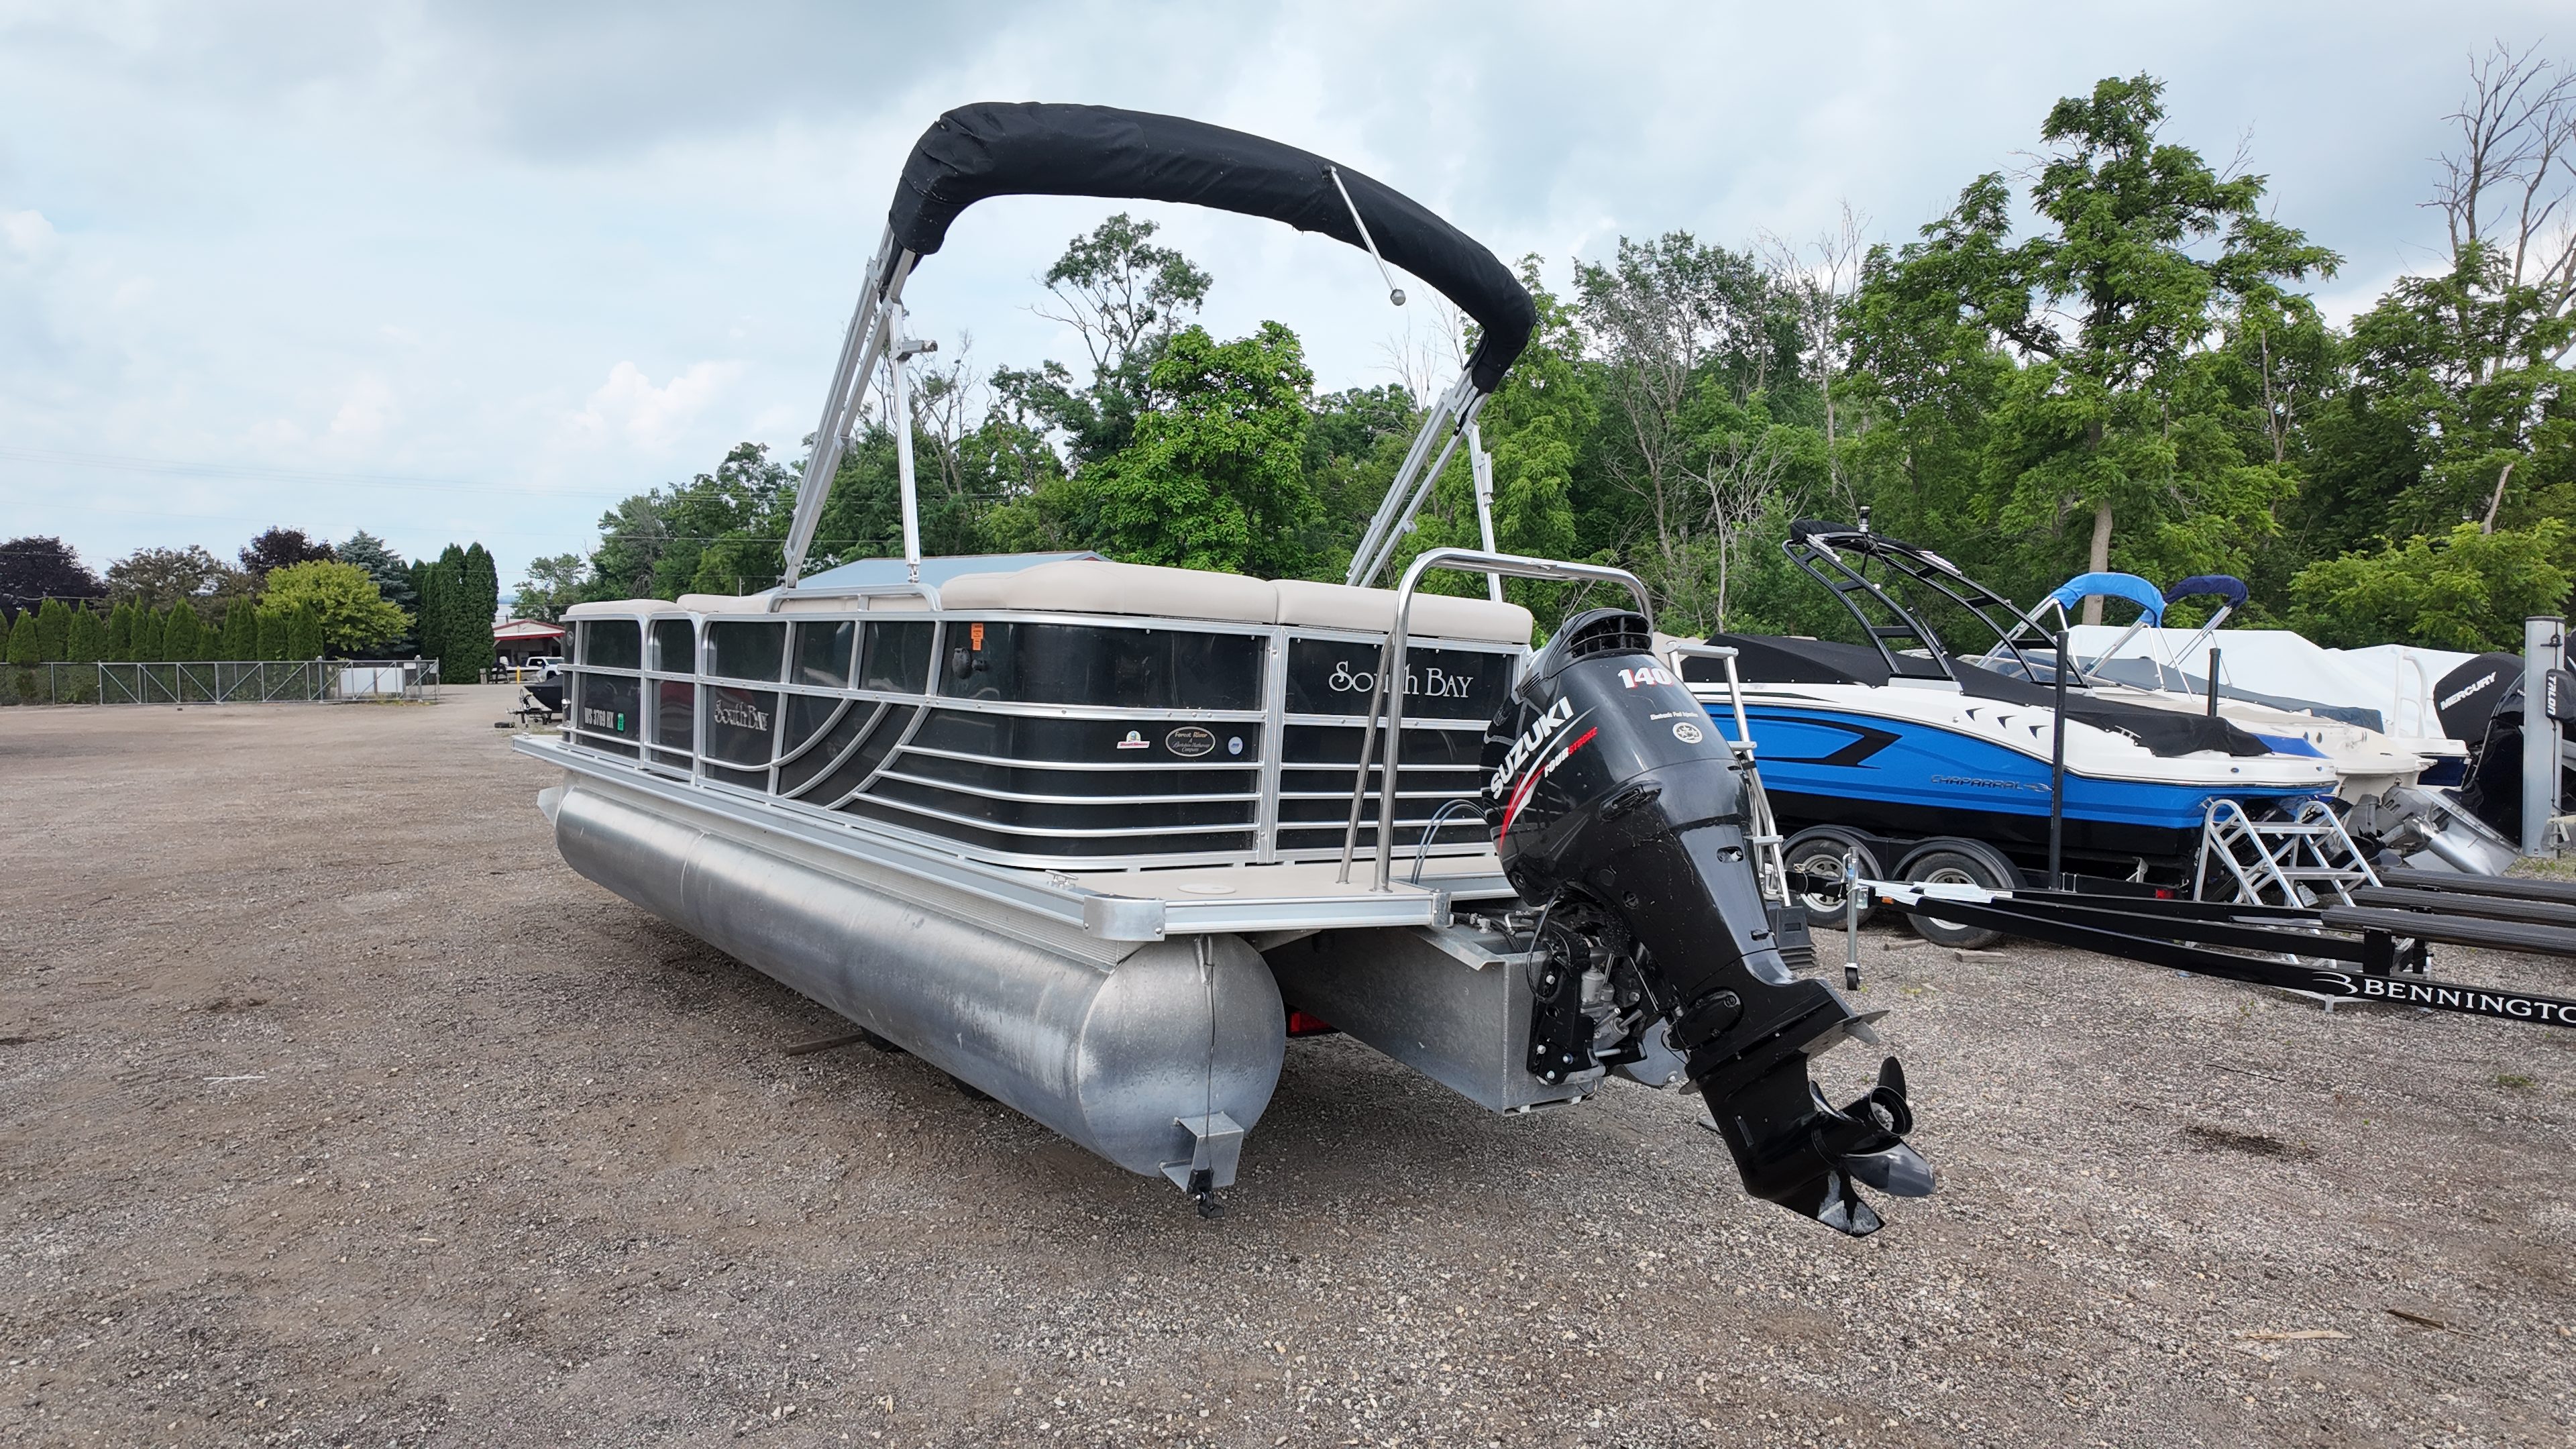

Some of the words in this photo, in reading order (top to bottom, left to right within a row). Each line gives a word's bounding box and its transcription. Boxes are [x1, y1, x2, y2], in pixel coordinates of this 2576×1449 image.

[1424, 667, 1474, 698] BAY
[1617, 667, 1674, 689] 140
[2440, 672, 2496, 711] MERCURY
[584, 707, 592, 724] WS
[606, 710, 614, 729] HX
[1491, 696, 1574, 800] SUZUKI
[1931, 774, 2024, 790] CHAPARRAL
